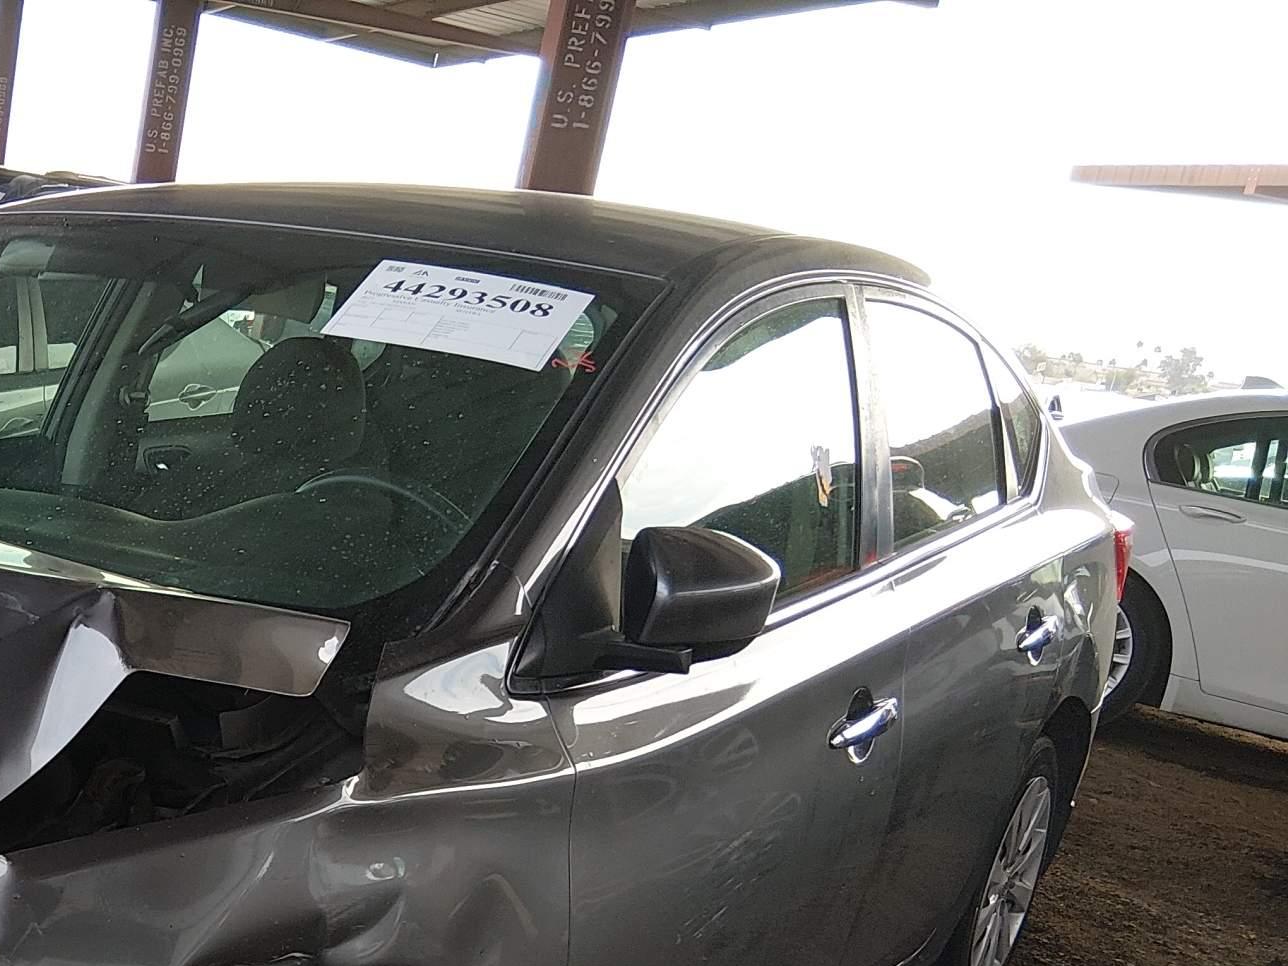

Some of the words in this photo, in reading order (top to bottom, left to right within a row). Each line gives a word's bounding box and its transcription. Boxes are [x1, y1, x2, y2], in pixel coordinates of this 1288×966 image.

[564, 0, 592, 68] PREF
[151, 60, 169, 118] PREFAB
[158, 27, 187, 153] 1-866-799-0969
[383, 279, 554, 318] 44293508
